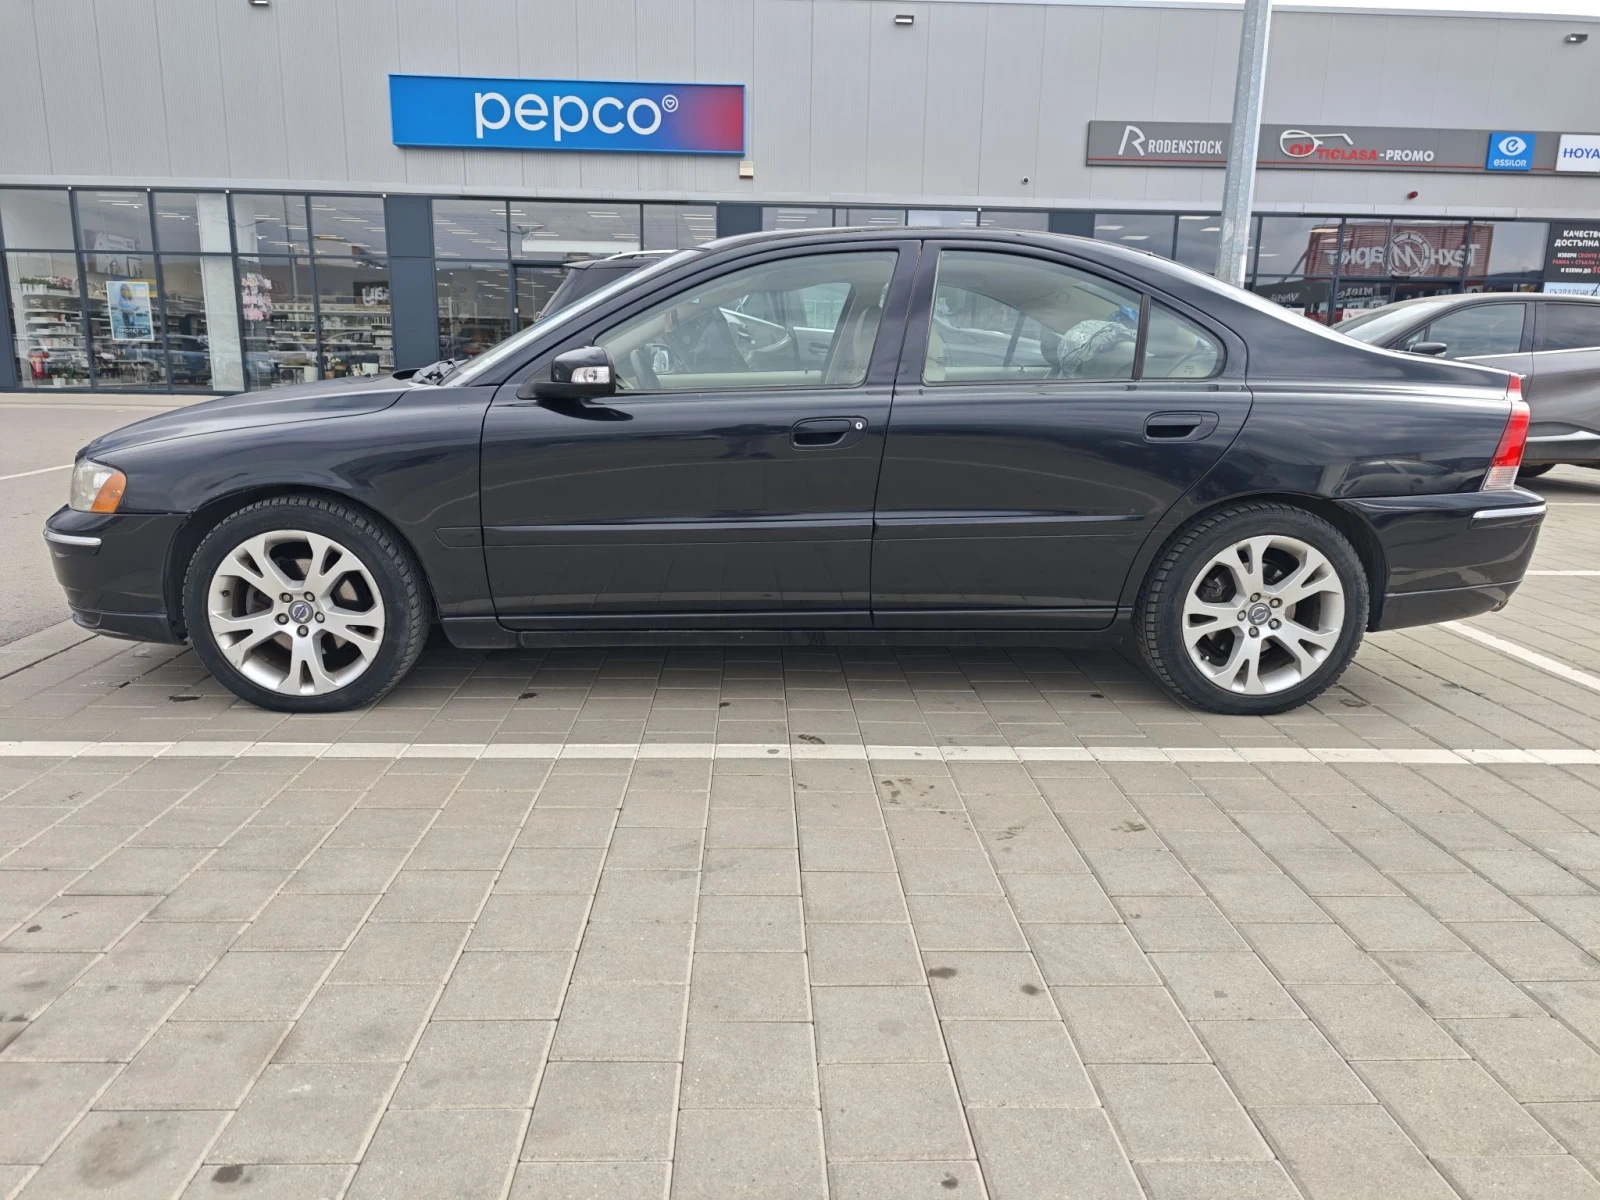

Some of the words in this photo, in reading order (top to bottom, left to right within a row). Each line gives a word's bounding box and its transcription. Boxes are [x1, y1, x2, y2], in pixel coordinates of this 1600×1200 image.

[474, 92, 662, 142] pepco
[1147, 139, 1223, 155] RODENSTOCK
[1563, 148, 1600, 159] HOYA
[1554, 239, 1599, 247] ДОСТЪПНА
